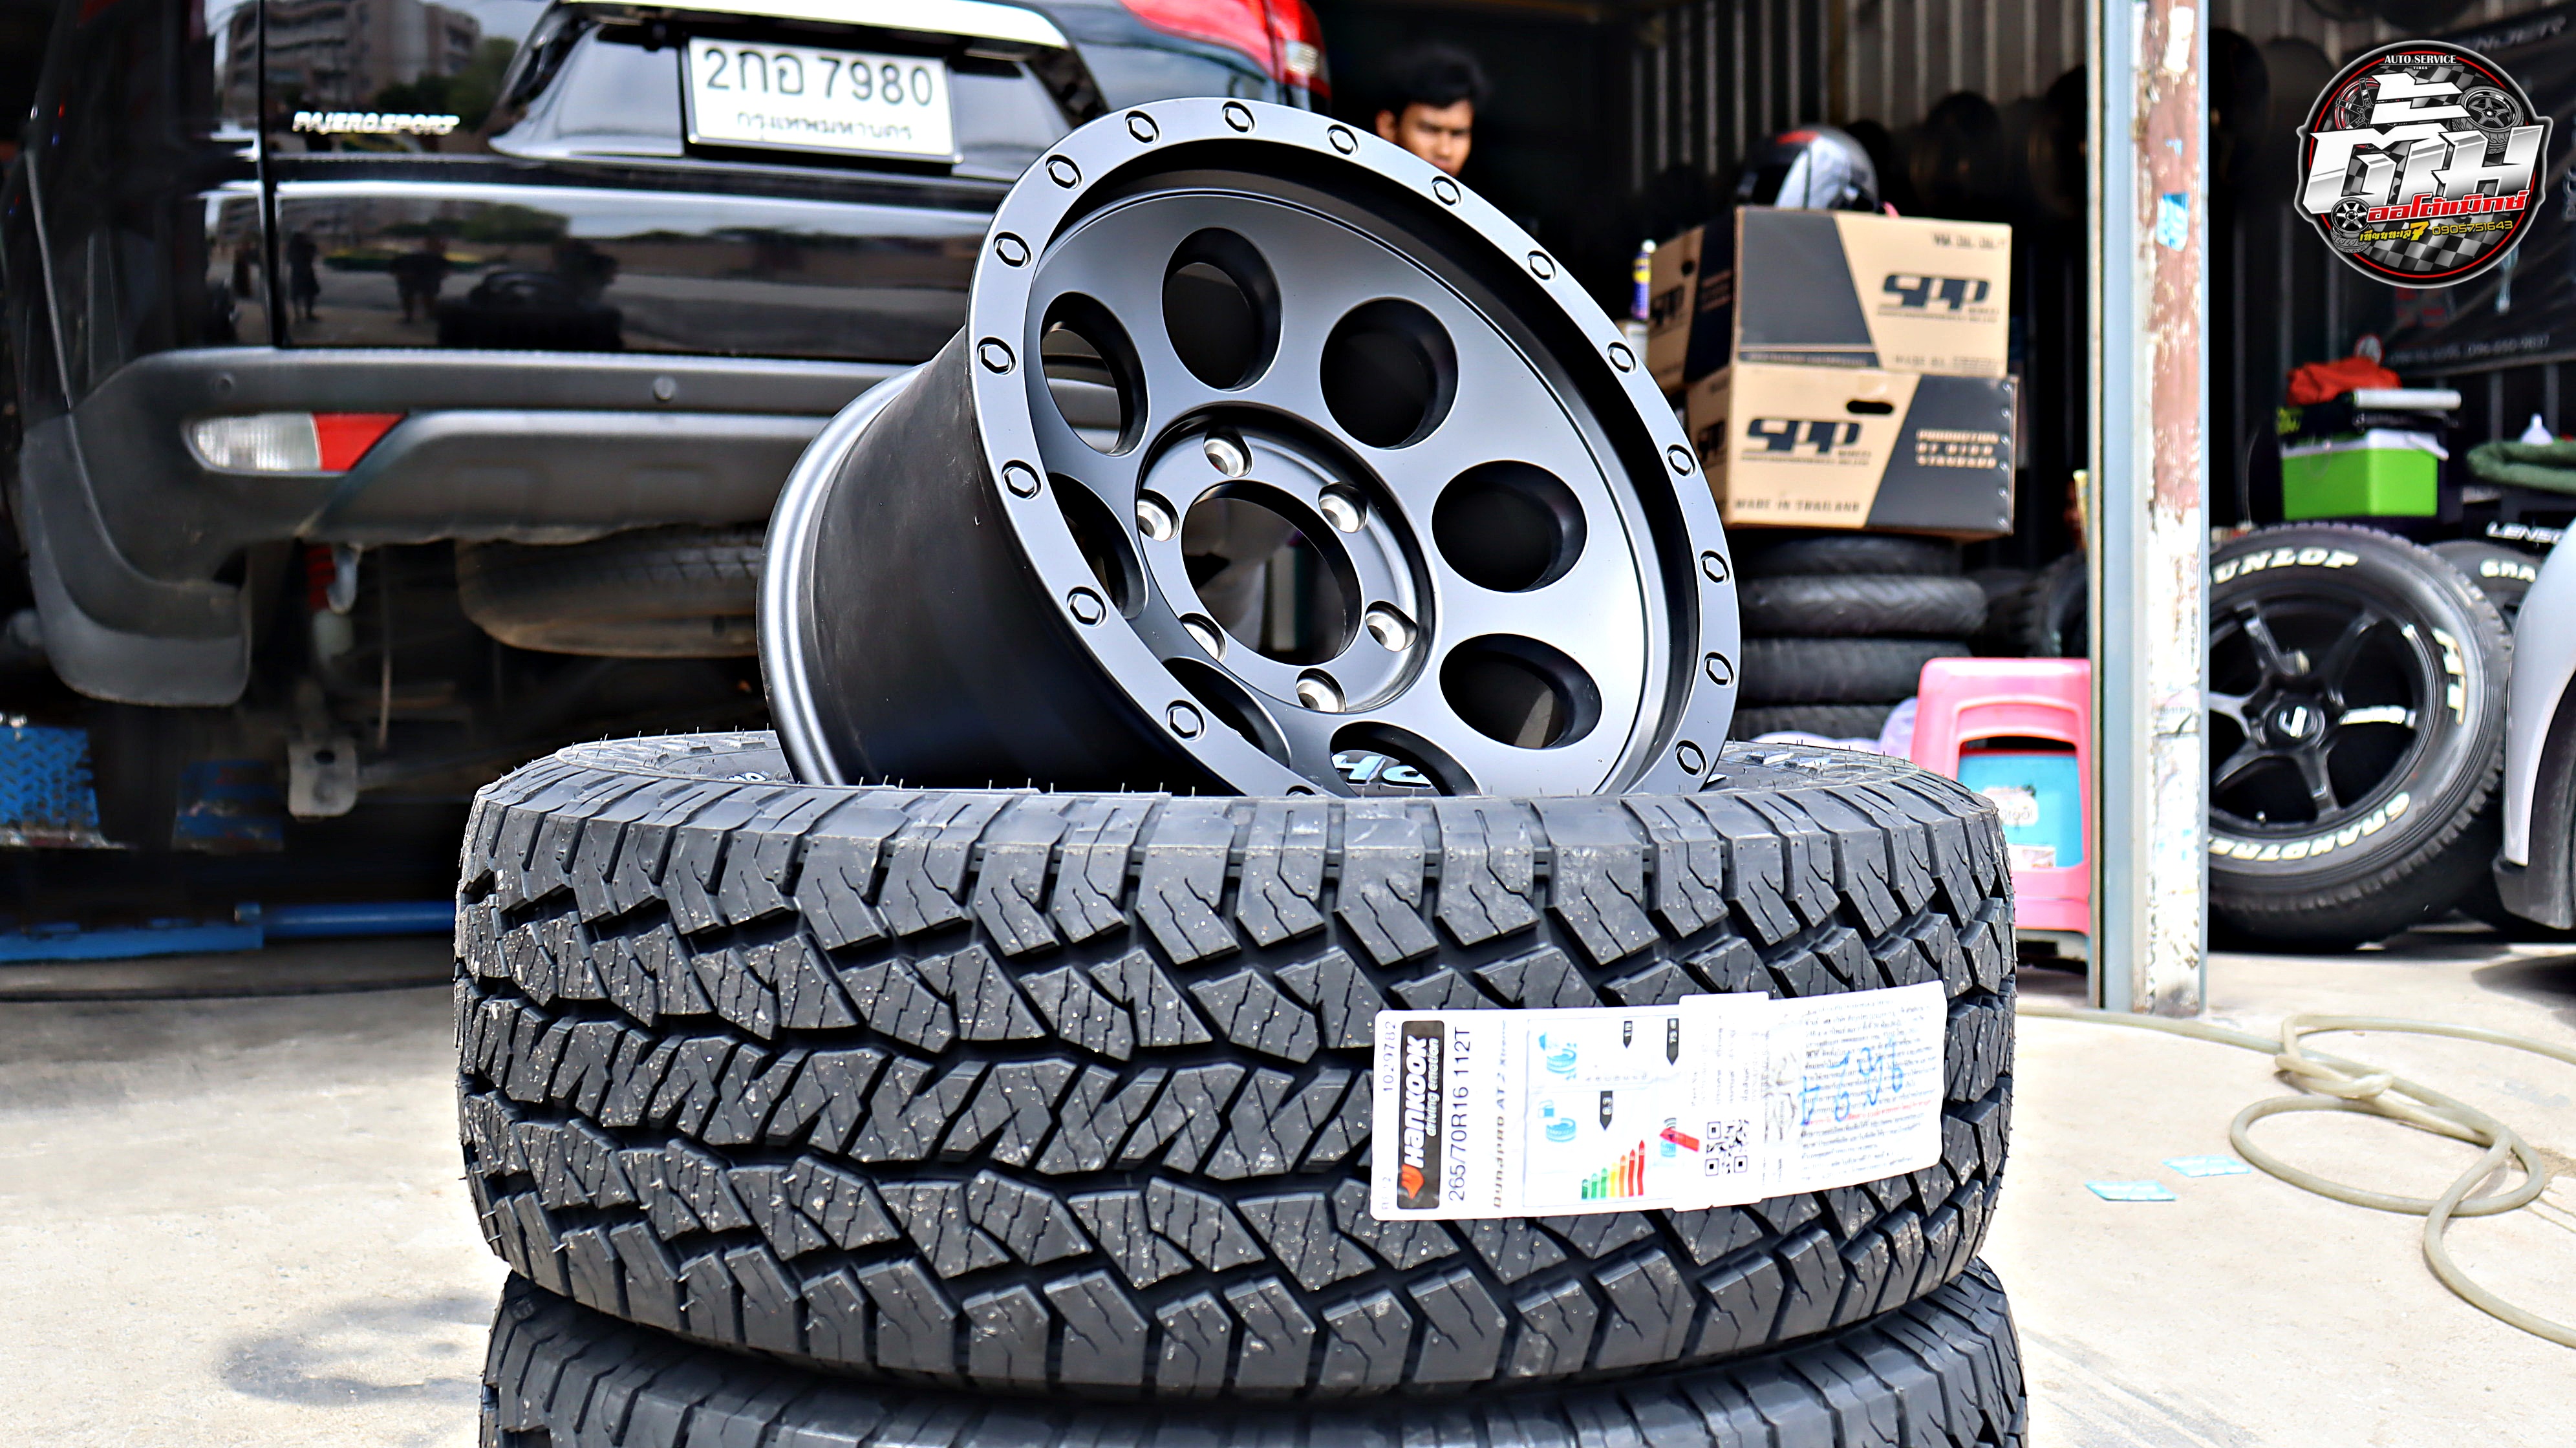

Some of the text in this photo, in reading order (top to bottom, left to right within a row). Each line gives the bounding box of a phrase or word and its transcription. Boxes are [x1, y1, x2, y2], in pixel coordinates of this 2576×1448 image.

[817, 56, 932, 107] 7980
[2209, 546, 2359, 585] UNLOP
[2208, 792, 2410, 862] GRANDTRE
[1426, 1038, 1439, 1137] driving emotion
[1448, 1026, 1471, 1202] 265/70R16 112T
